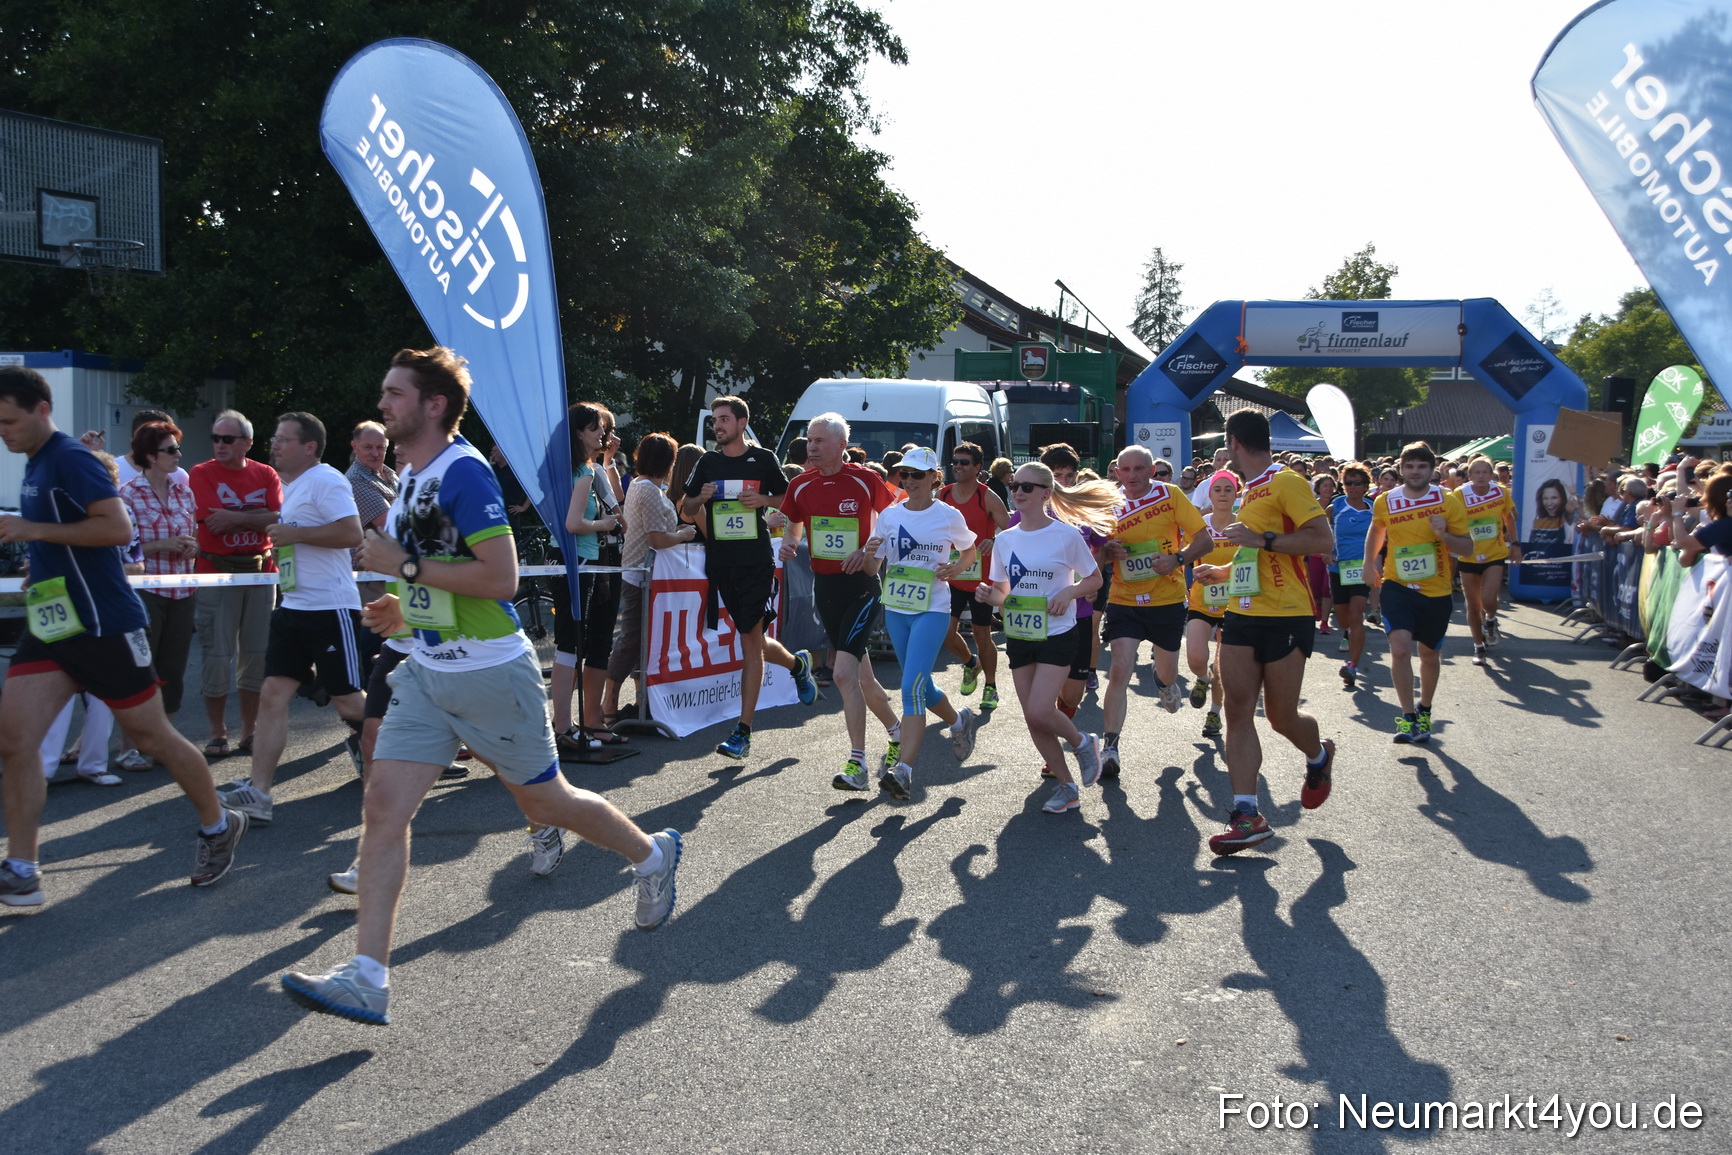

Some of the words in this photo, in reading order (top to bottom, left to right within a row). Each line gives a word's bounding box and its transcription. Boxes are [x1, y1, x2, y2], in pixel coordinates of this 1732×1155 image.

[1327, 333, 1410, 348] firmenlauf
[1176, 361, 1219, 370] Fischer
[1637, 421, 1666, 452] AOK
[1116, 515, 1143, 534] MAX
[1144, 502, 1174, 520] BÖGL
[1389, 514, 1415, 525] MAX
[1417, 507, 1446, 519] BÖGL
[1467, 507, 1486, 516] MAX
[726, 516, 744, 529] 45
[1474, 526, 1492, 535] 946
[824, 534, 844, 549] 35
[1126, 556, 1152, 572] 900
[1402, 558, 1428, 572] 921
[1235, 566, 1252, 583] 907
[407, 585, 431, 610] 29
[888, 581, 927, 601] 1475
[37, 603, 67, 627] 379
[1006, 612, 1043, 629] 1478
